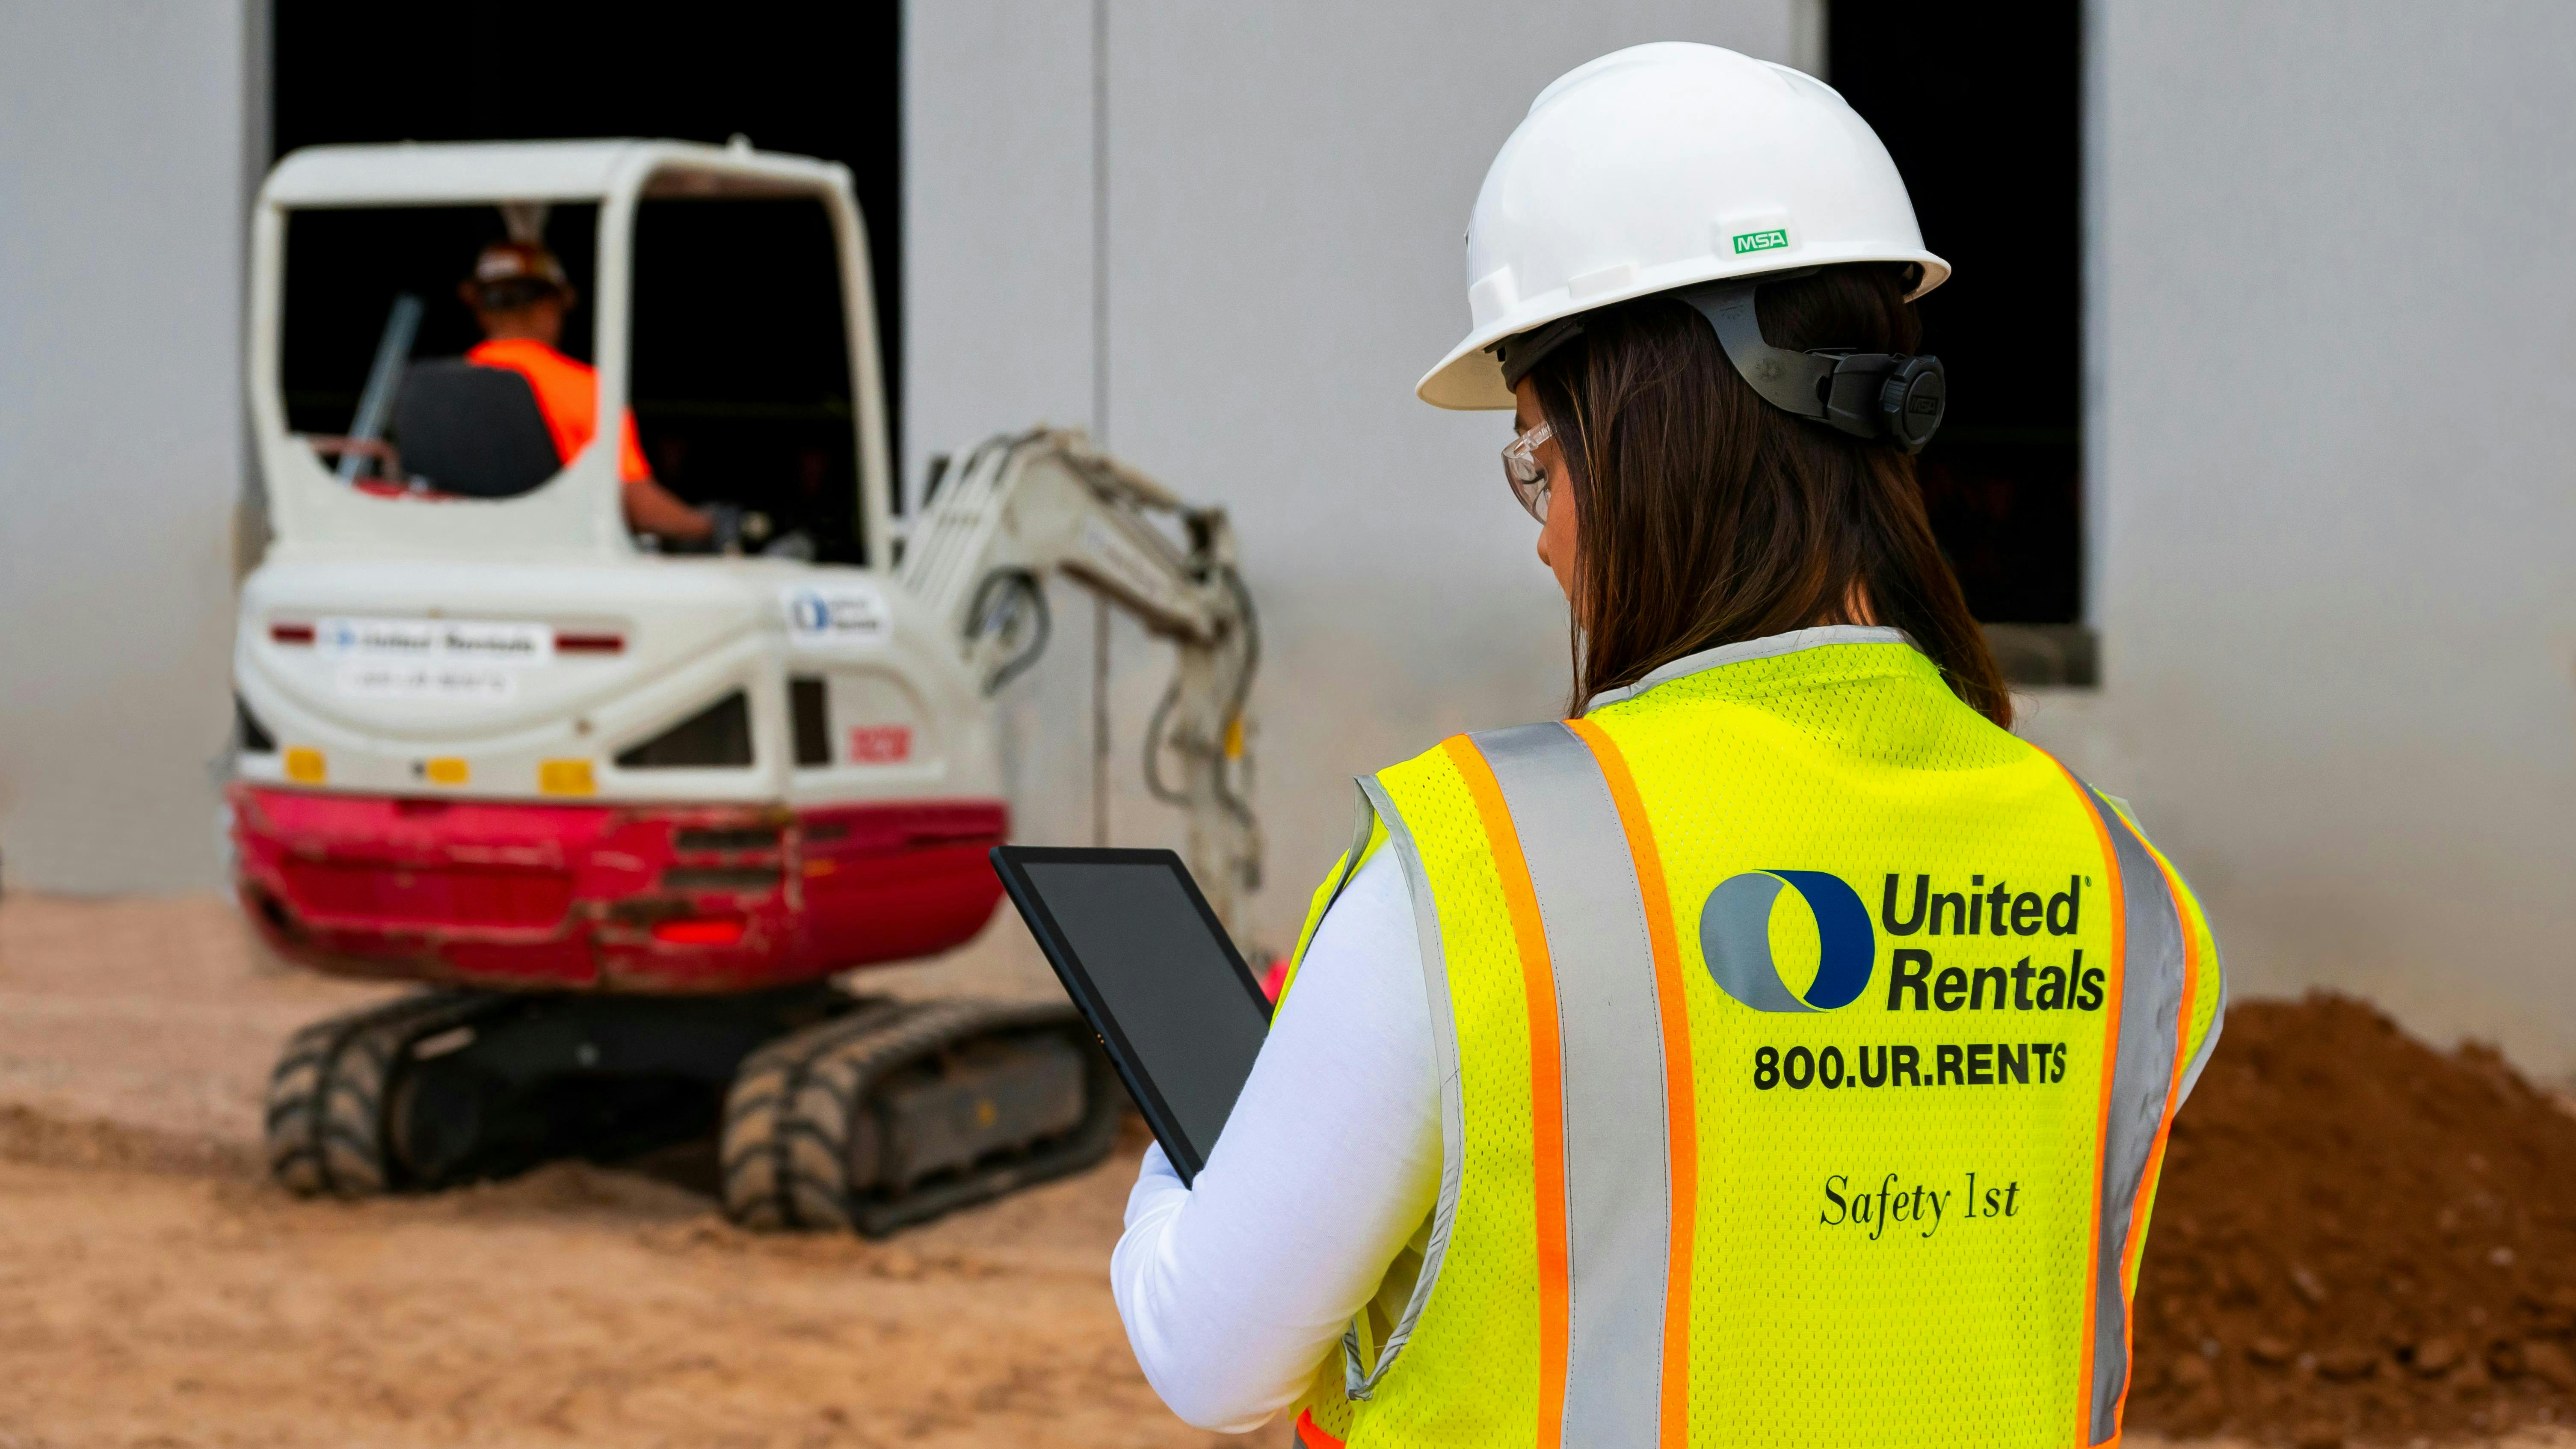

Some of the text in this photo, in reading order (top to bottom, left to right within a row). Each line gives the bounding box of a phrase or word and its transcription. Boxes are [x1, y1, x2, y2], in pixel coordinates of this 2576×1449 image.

[1738, 232, 1786, 252] MSA
[1910, 397, 1936, 414] MSA
[1887, 949, 2104, 1011] Rentals
[1754, 1043, 2066, 1090] 800.UR.RENTS
[1820, 1172, 2020, 1240] Safety 1st
